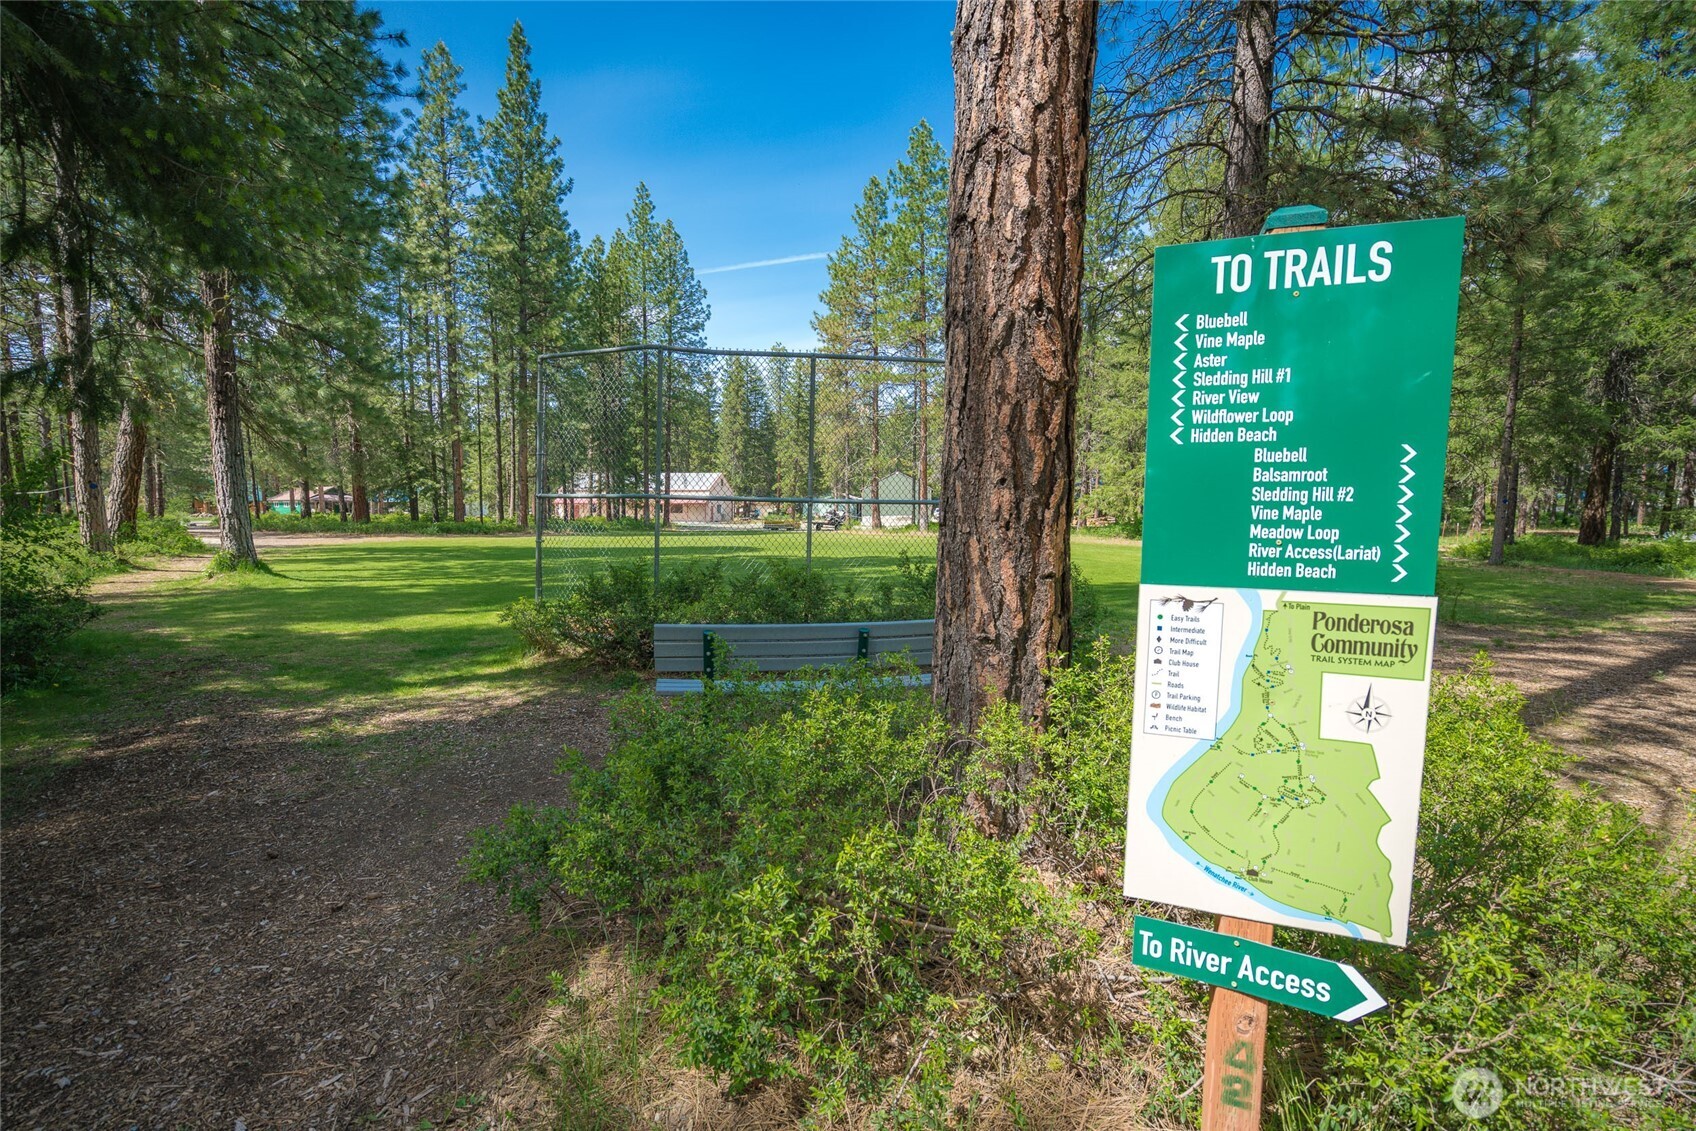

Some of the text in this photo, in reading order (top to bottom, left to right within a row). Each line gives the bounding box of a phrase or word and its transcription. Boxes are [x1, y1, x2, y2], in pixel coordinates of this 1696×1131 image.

[1211, 241, 1393, 294] TO TRAILS
[1196, 312, 1248, 330] Bluebell
[1195, 331, 1266, 350] Vine Maple
[1193, 354, 1228, 368] Aster
[1193, 368, 1291, 389] Sledding Hill #1
[1192, 389, 1260, 406] River View
[1191, 408, 1294, 426] Wildflower Loop
[1190, 427, 1277, 443] Hidden Beach
[1254, 448, 1308, 463] Bluebell
[1252, 468, 1328, 482] Balsamroot
[1251, 487, 1355, 507] Sledding Hill #2
[1250, 506, 1323, 524] Vine Maple
[1249, 524, 1340, 544] Meadow Loop
[1248, 543, 1381, 563] River Access(Lariat)
[1247, 562, 1337, 579] Hidden Beach
[1296, 603, 1311, 611] Plain
[1170, 614, 1200, 624] Easy Trails
[1312, 611, 1415, 636] Ponderosa
[1170, 625, 1206, 635] Intermediate
[1169, 636, 1207, 646] More Difficult
[1311, 632, 1418, 664] Community
[1169, 647, 1194, 657] Trail Map
[1168, 658, 1200, 668] Club House
[1311, 655, 1335, 663] TRAIL
[1338, 657, 1371, 666] SYSTEM
[1168, 669, 1180, 678] Trail
[1167, 680, 1184, 689] Roads
[1166, 691, 1201, 703] Trail Parking
[1166, 703, 1207, 714] Wildlife Habitat
[1365, 710, 1373, 718] N
[1165, 713, 1183, 722] Bench
[1164, 724, 1198, 735] Picnic Table
[1203, 865, 1247, 893] Wenatchee River
[1139, 930, 1331, 1002] To River Access
